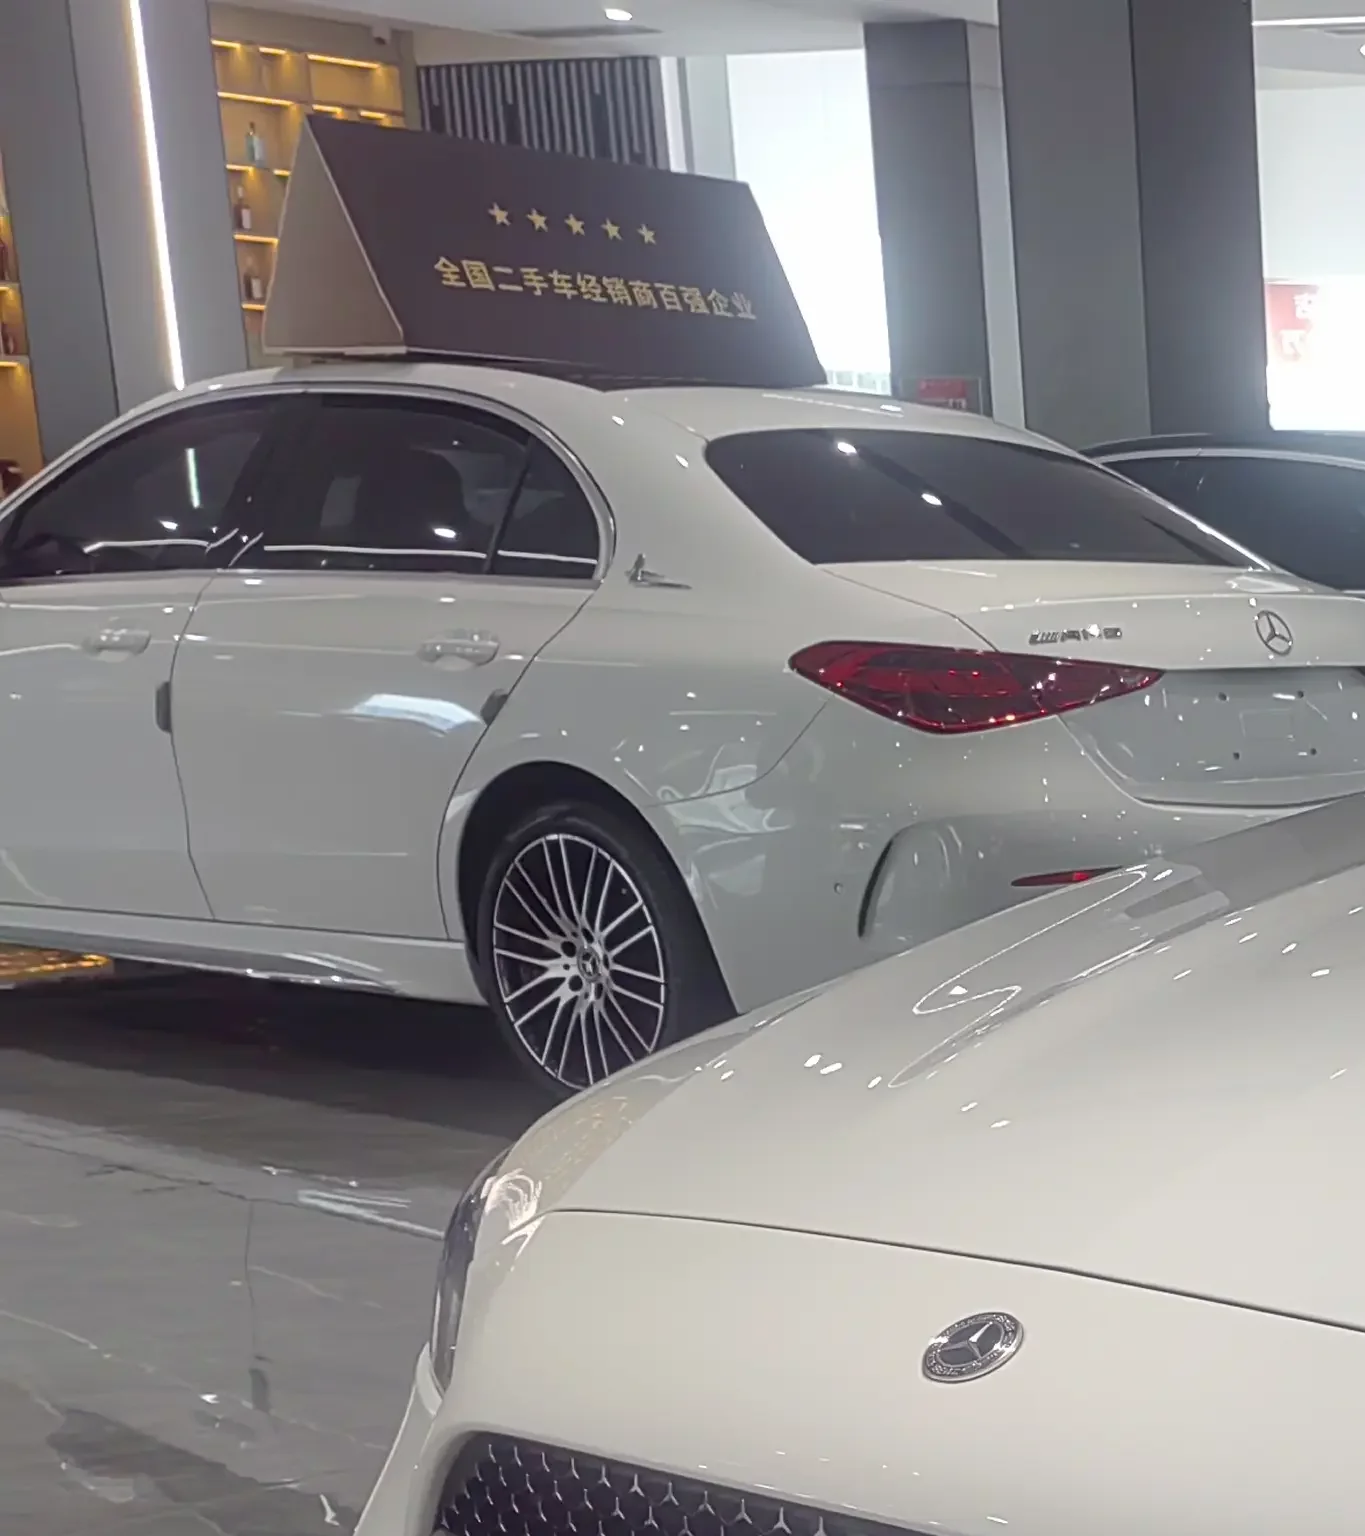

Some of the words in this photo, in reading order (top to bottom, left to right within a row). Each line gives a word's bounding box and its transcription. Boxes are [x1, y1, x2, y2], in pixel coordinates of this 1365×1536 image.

[434, 256, 756, 320] 全国二手车经销商百强企业
